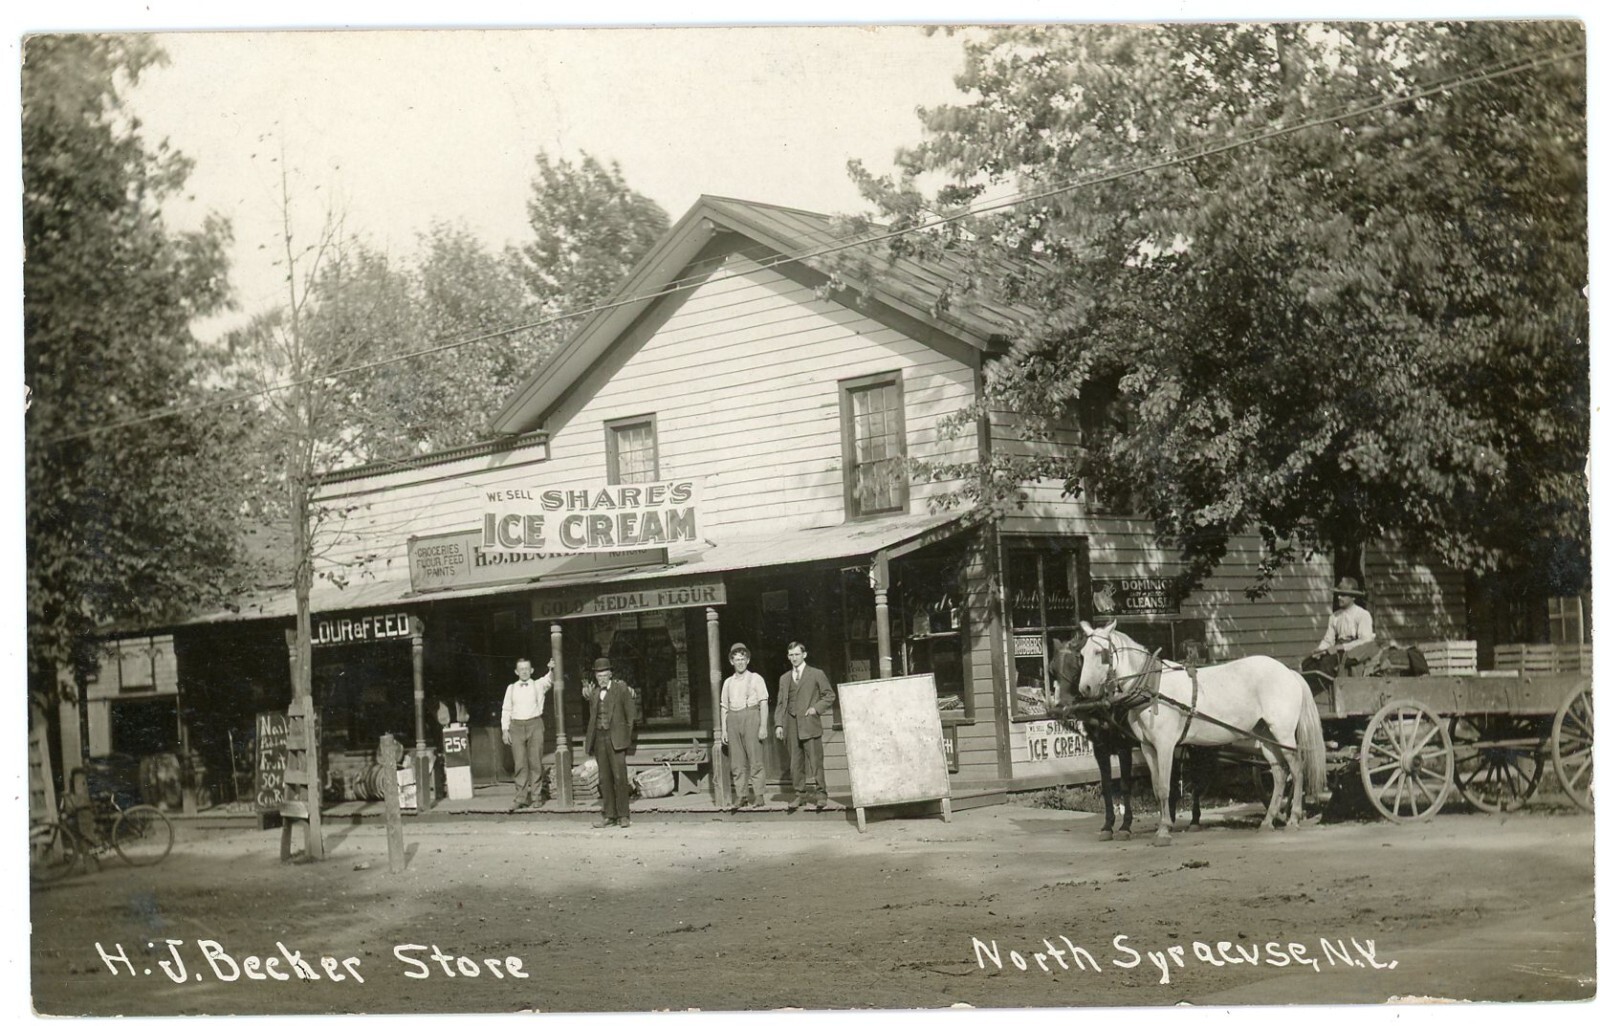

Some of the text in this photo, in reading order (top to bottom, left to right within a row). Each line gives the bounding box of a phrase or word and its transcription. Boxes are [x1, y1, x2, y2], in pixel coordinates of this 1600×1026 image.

[486, 481, 694, 512] WE SELL SHARE'S
[483, 506, 697, 550] ICE CREAM
[417, 543, 460, 558] GROCERIES
[427, 565, 456, 578] PAINTS
[541, 585, 717, 616] GOLD MEDAL FLOUR
[443, 736, 469, 754] 25¢
[1028, 738, 1049, 761] ICE
